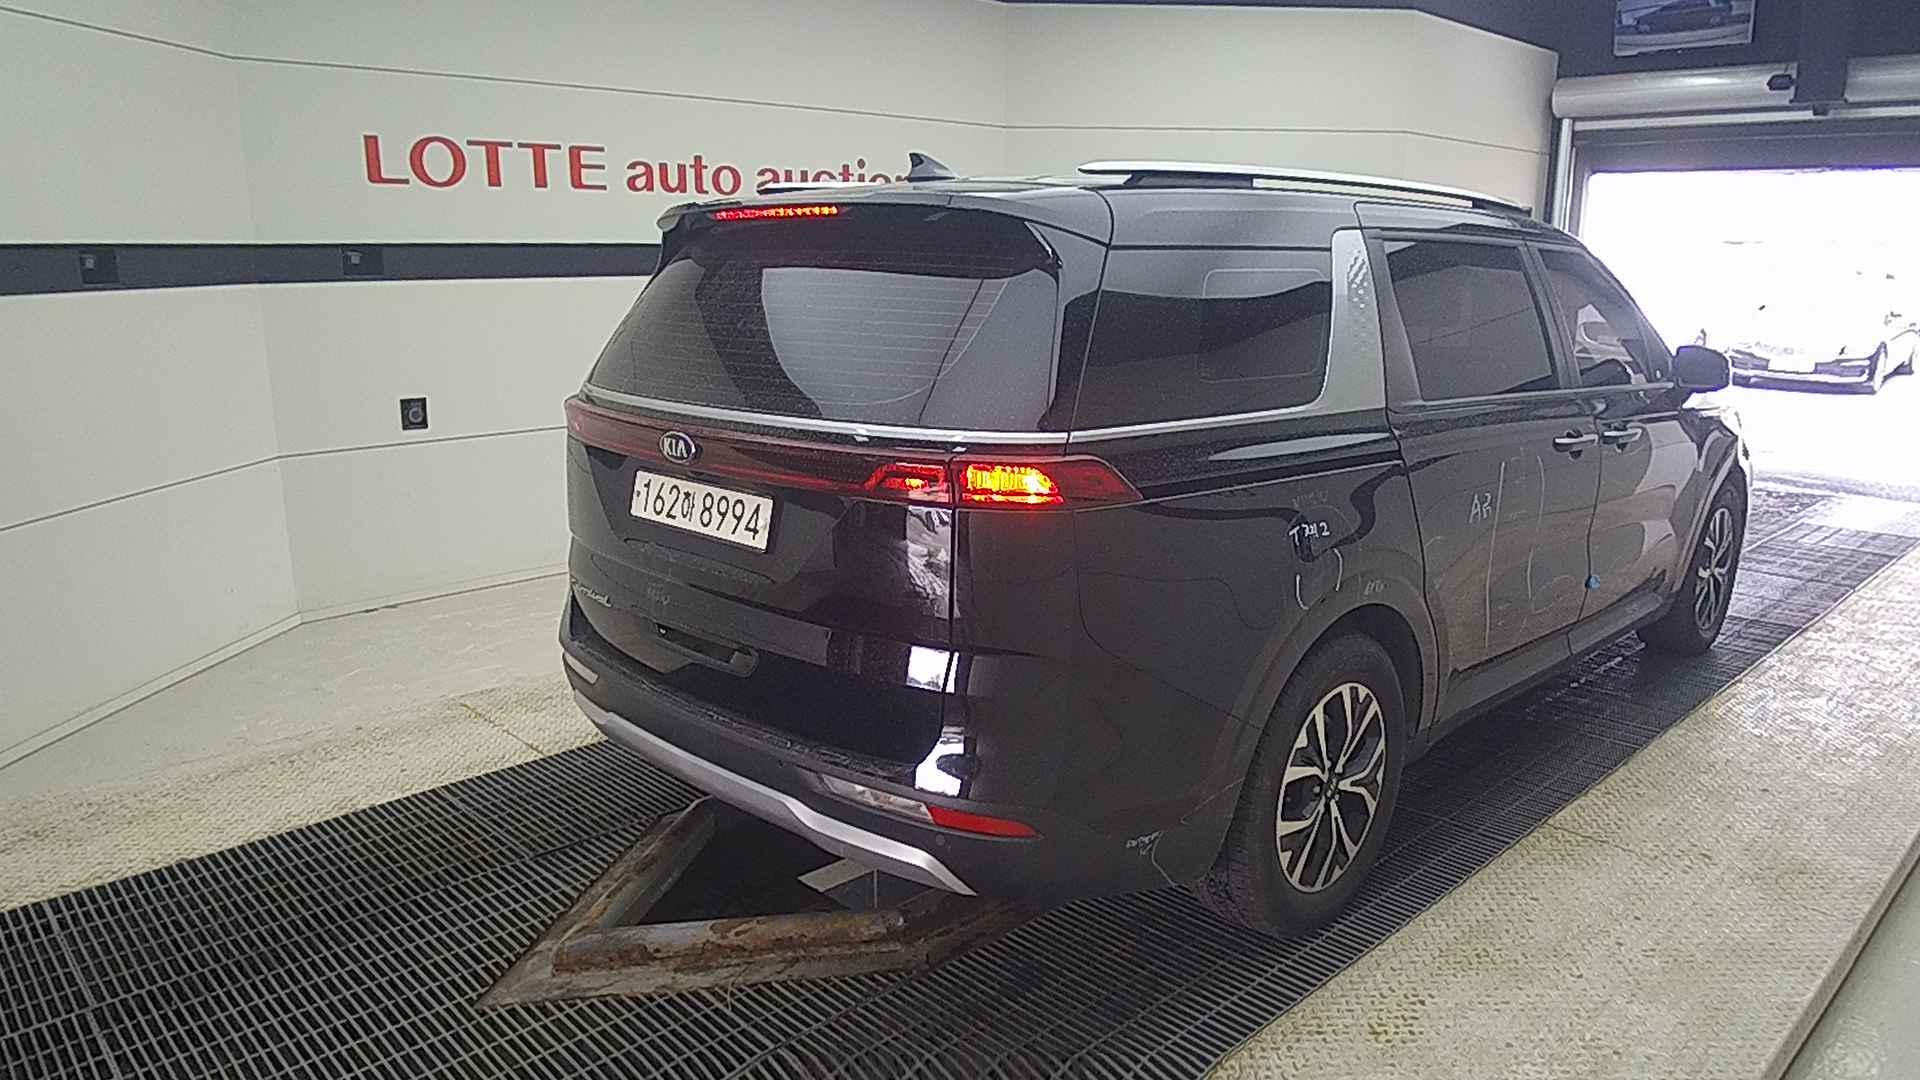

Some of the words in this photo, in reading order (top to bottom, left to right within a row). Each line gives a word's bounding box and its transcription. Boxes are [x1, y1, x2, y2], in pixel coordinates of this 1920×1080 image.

[363, 134, 607, 191] LOTTE
[626, 155, 741, 196] auto
[756, 158, 905, 188] auti
[663, 437, 688, 458] KIA
